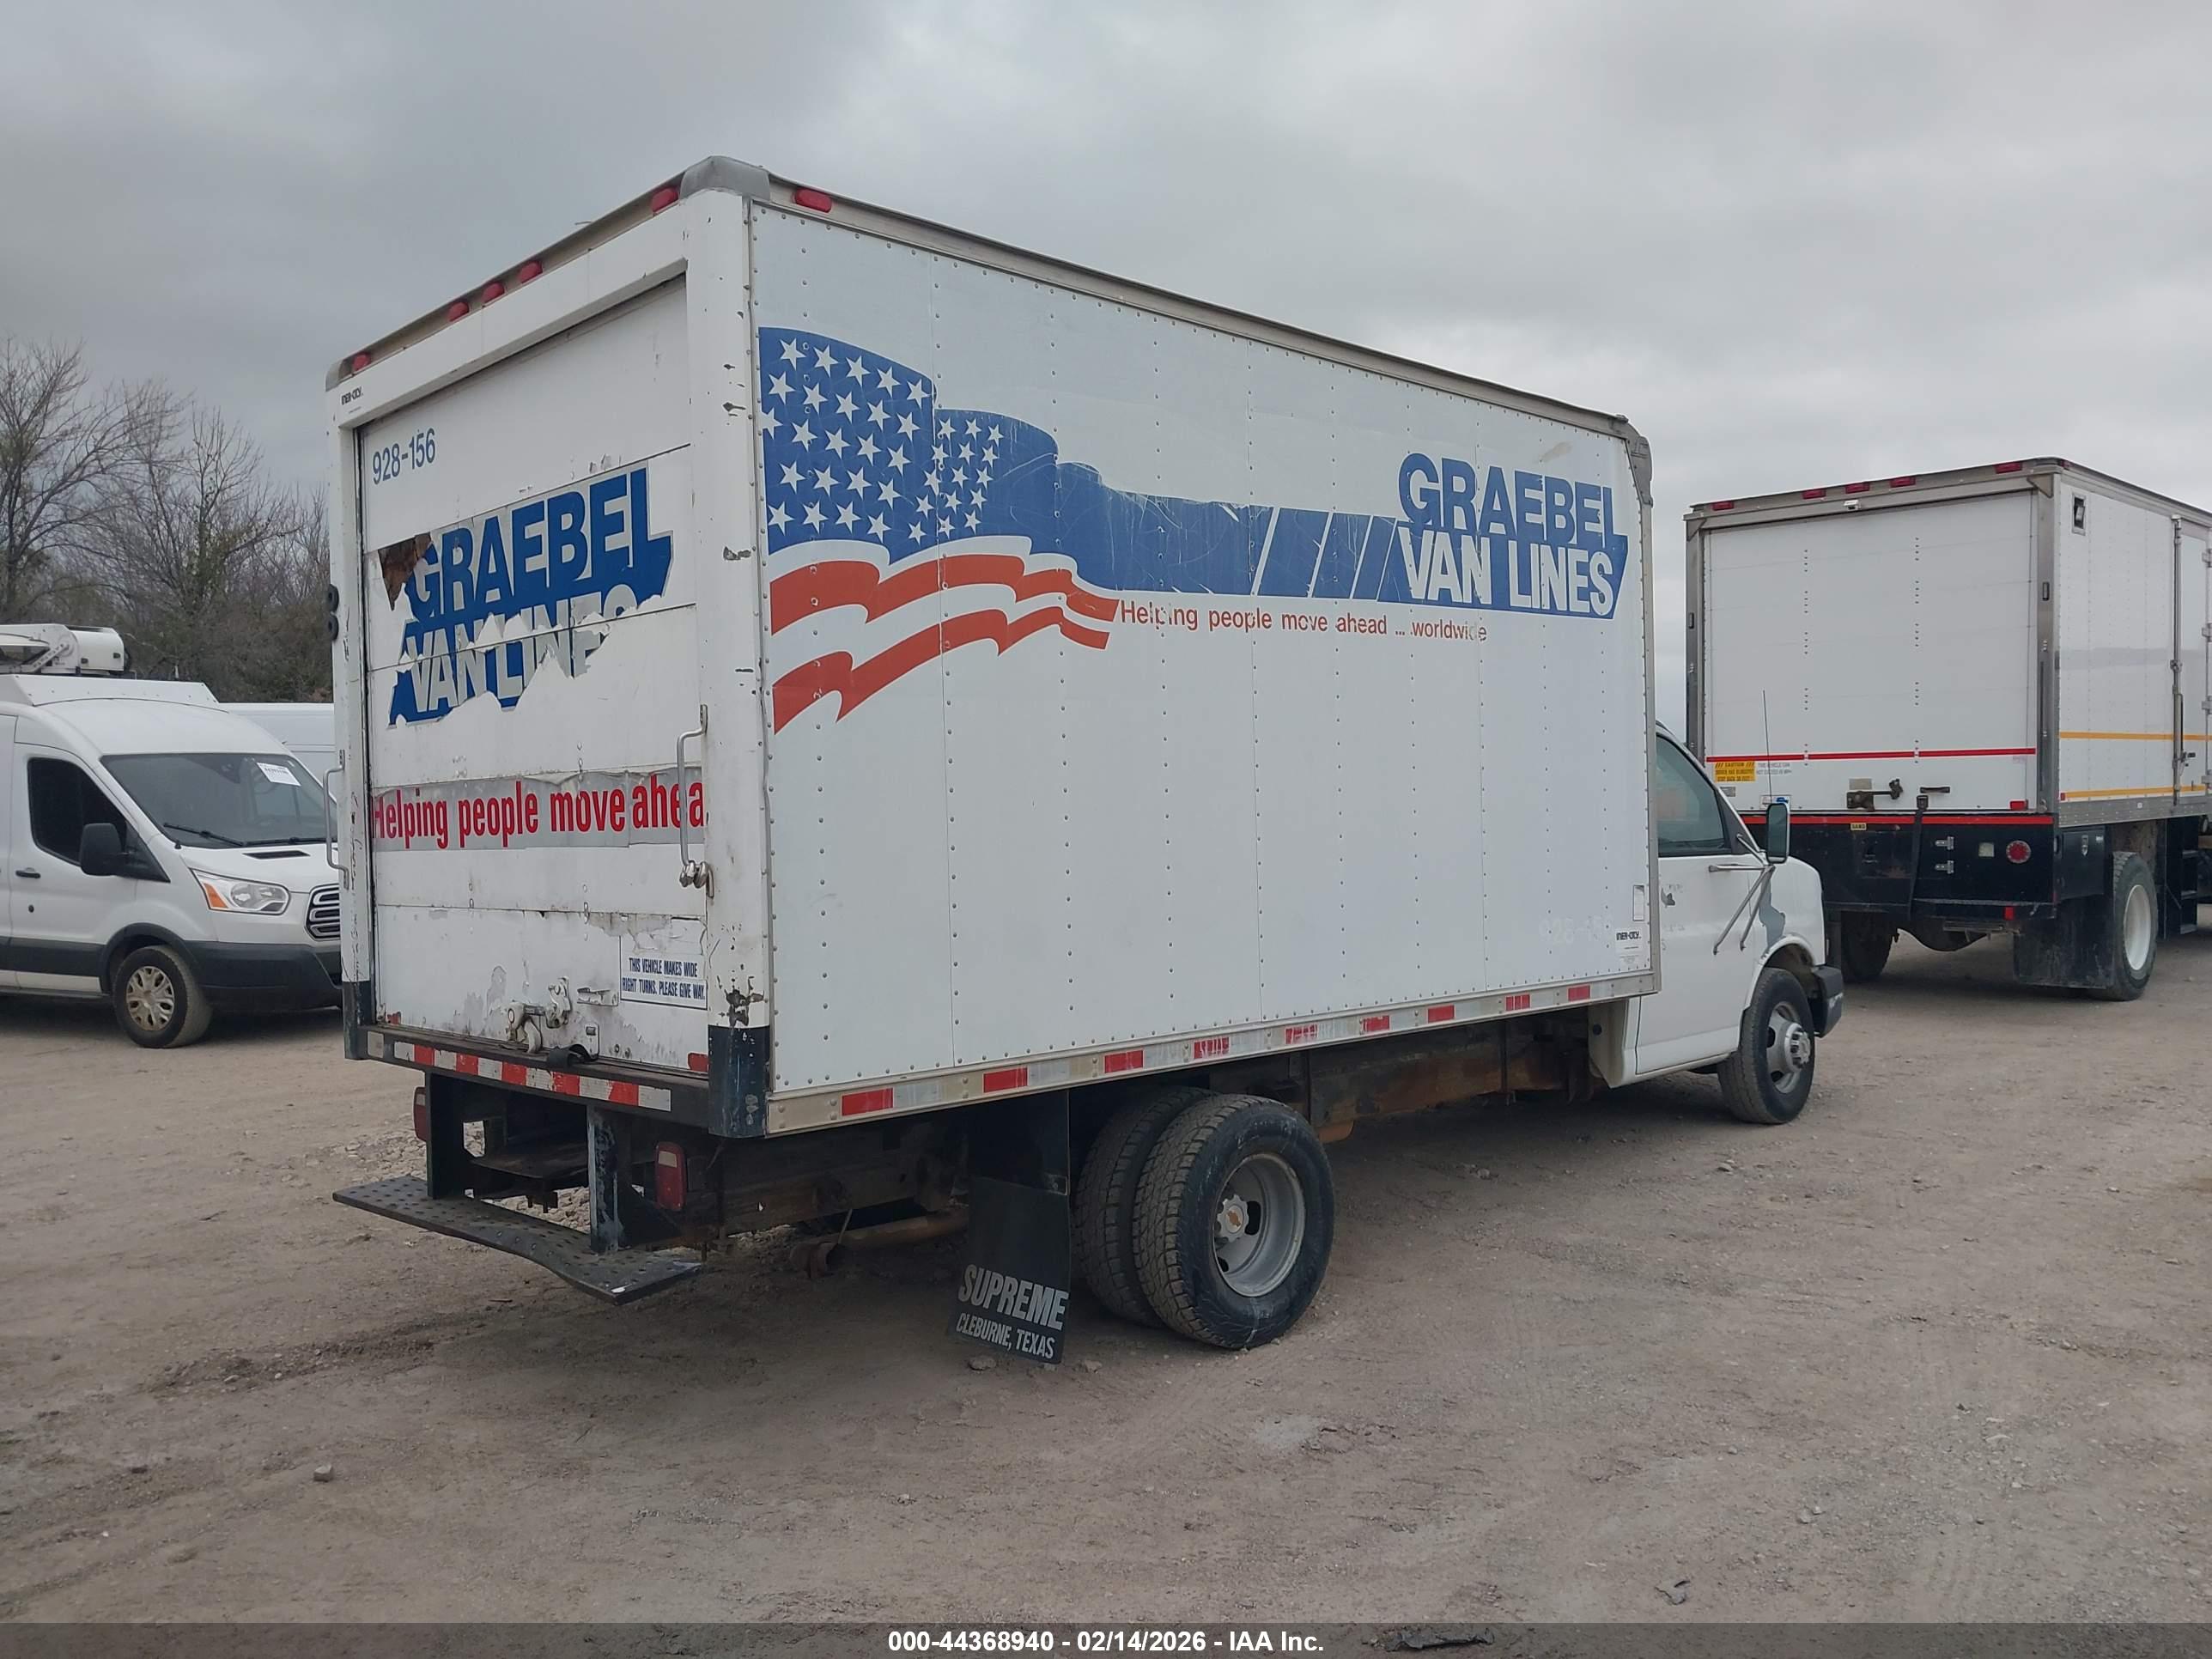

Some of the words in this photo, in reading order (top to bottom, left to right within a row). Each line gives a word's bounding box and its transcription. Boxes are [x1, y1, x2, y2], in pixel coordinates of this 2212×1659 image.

[373, 428, 435, 485] 928-156
[1399, 453, 1627, 548] GRAEBEL
[405, 467, 670, 620] GRAEBEL
[1398, 526, 1492, 605] VAN
[1508, 538, 1613, 616] LINES
[1209, 607, 1273, 633] people
[1282, 613, 1328, 631] move
[1337, 612, 1388, 635] ahead
[406, 619, 487, 713] VAN
[371, 787, 448, 848] Helping
[459, 781, 538, 848] people
[550, 788, 625, 832] move
[623, 977, 636, 993] RIGHT
[639, 979, 658, 994] TURNS.
[659, 981, 678, 997] PLEASE
[679, 982, 691, 998] GIVE
[629, 957, 641, 972] THIS
[642, 958, 662, 975] VEHICLE
[664, 960, 682, 976] MAKES
[684, 962, 697, 977] WIDE
[957, 1264, 1069, 1330] SUPREME
[956, 1312, 1012, 1351] CLEBURNE,
[1016, 1328, 1055, 1358] TEXAS
